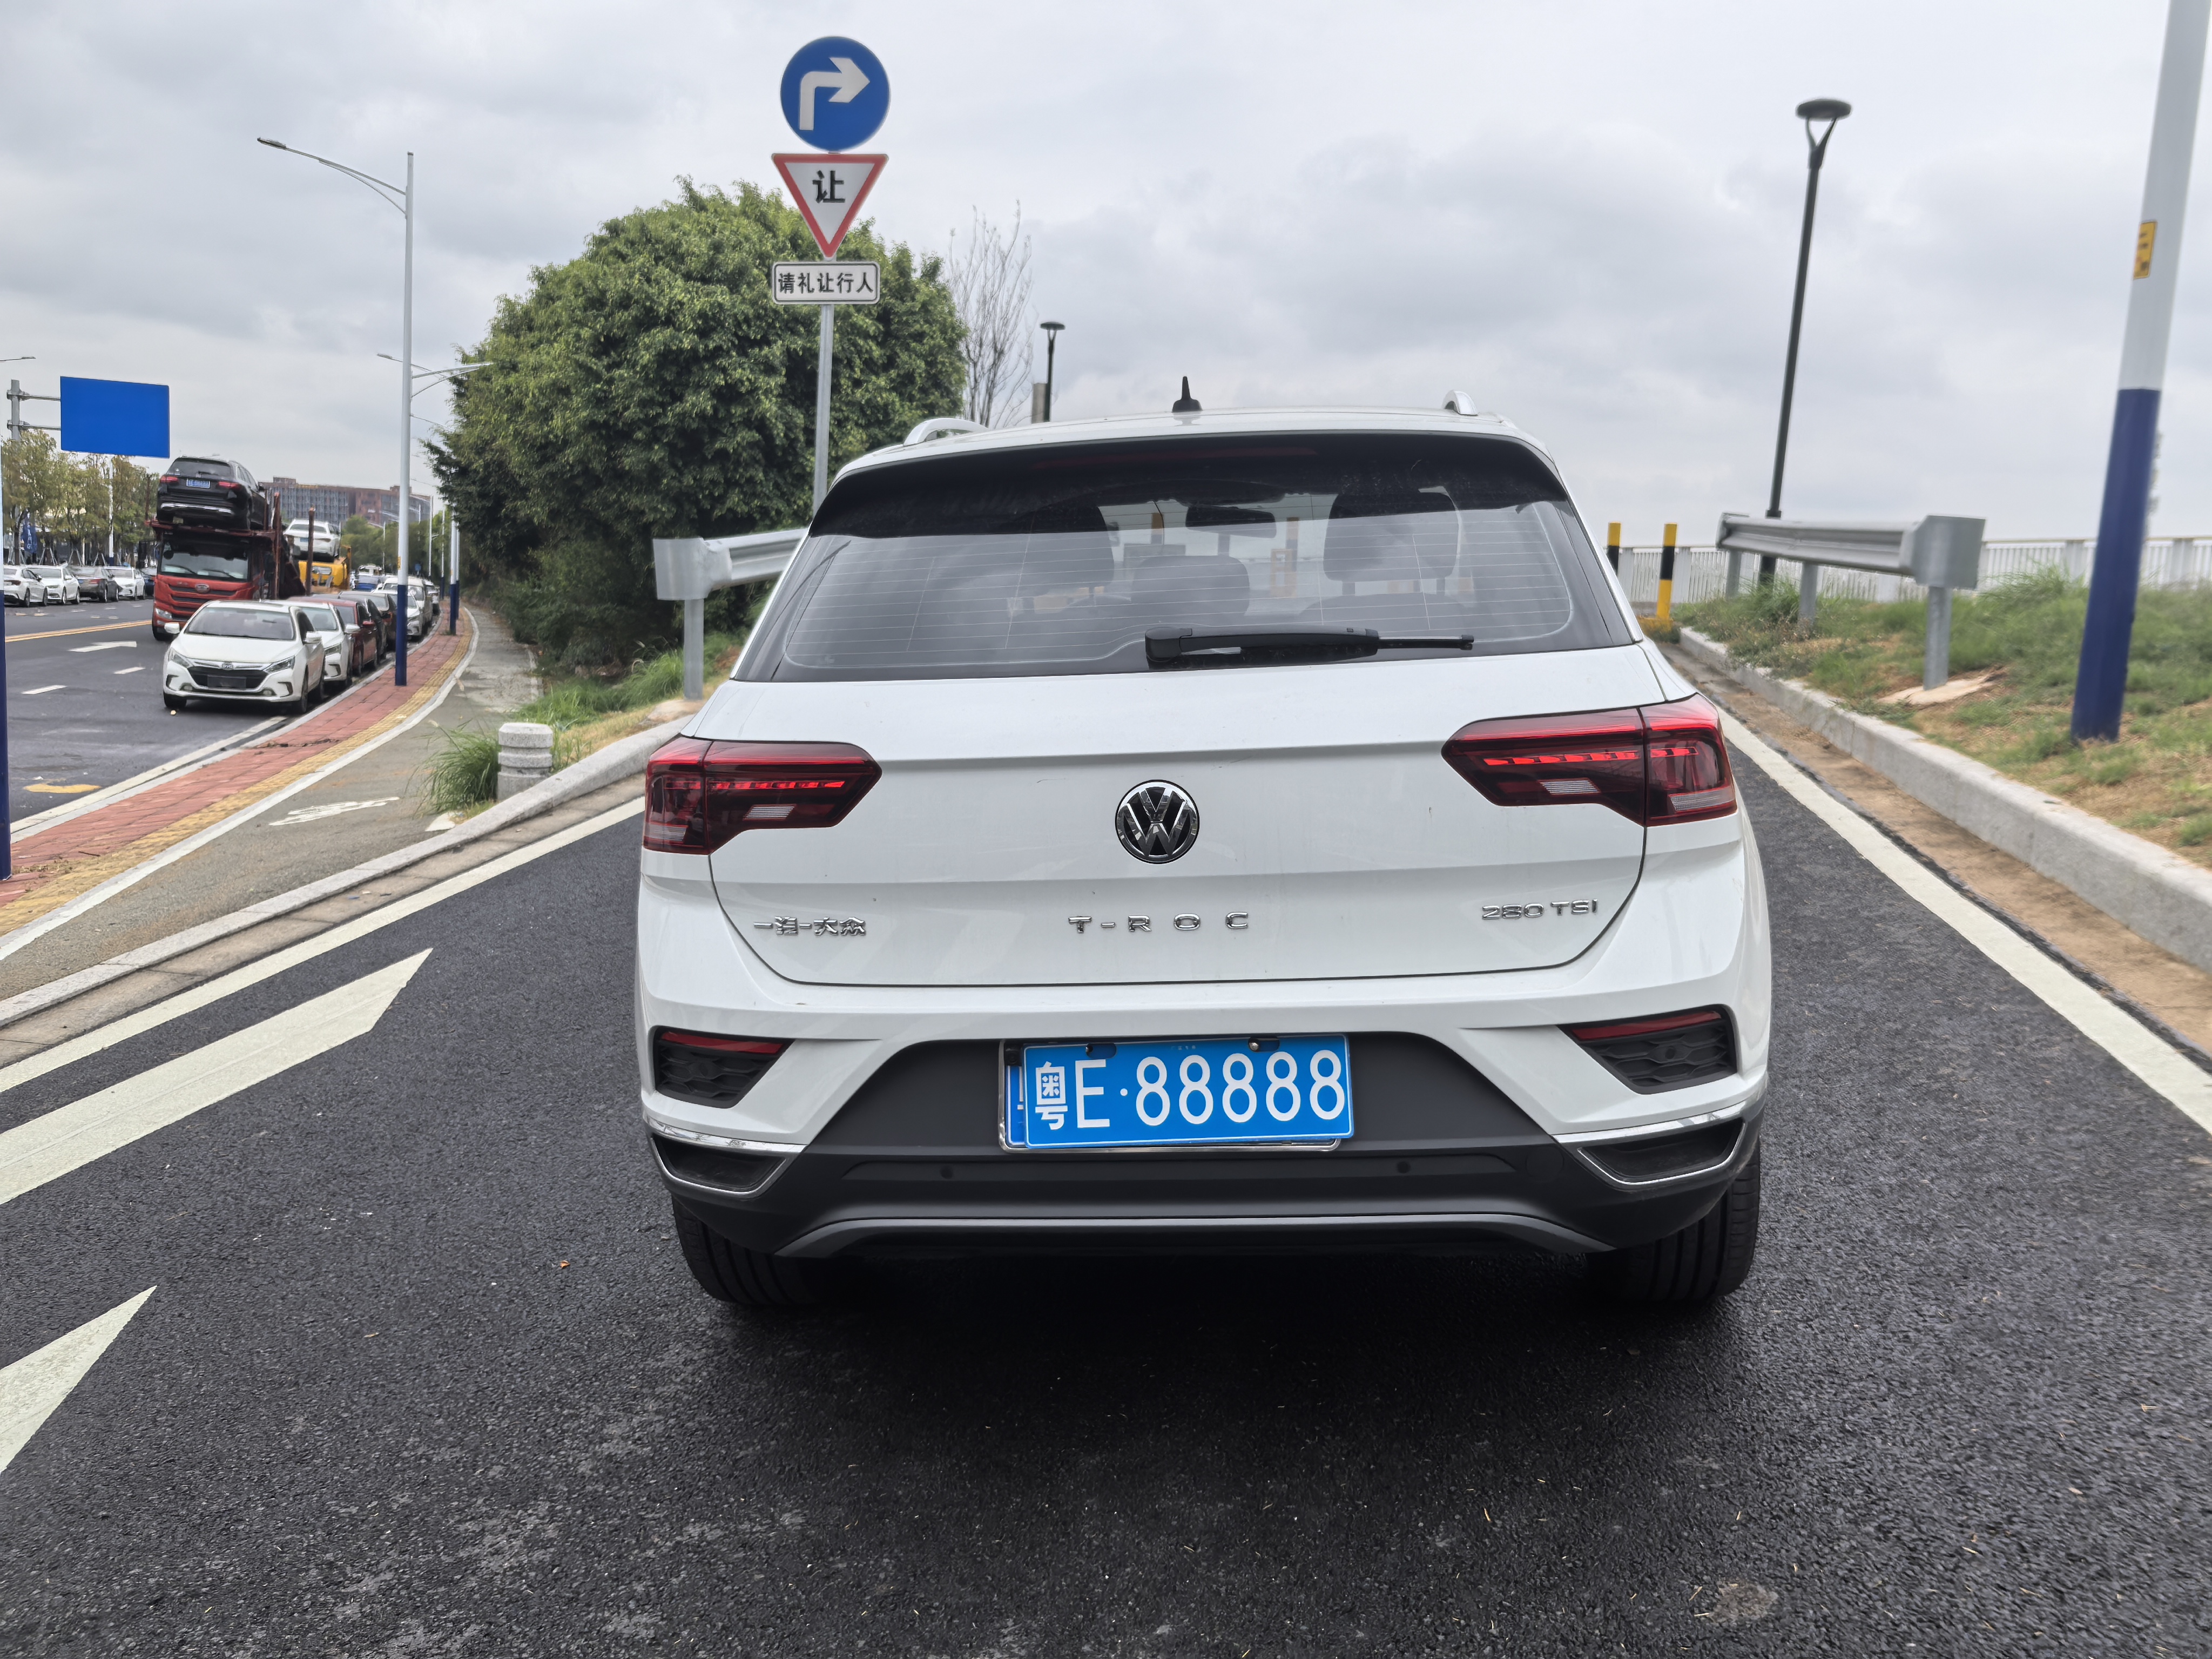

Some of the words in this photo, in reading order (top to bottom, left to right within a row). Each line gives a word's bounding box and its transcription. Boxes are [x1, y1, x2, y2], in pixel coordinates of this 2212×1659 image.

[813, 170, 845, 203] 让
[778, 272, 874, 294] 请礼让行人
[1482, 902, 1545, 920] 280
[1550, 899, 1598, 916] TSI
